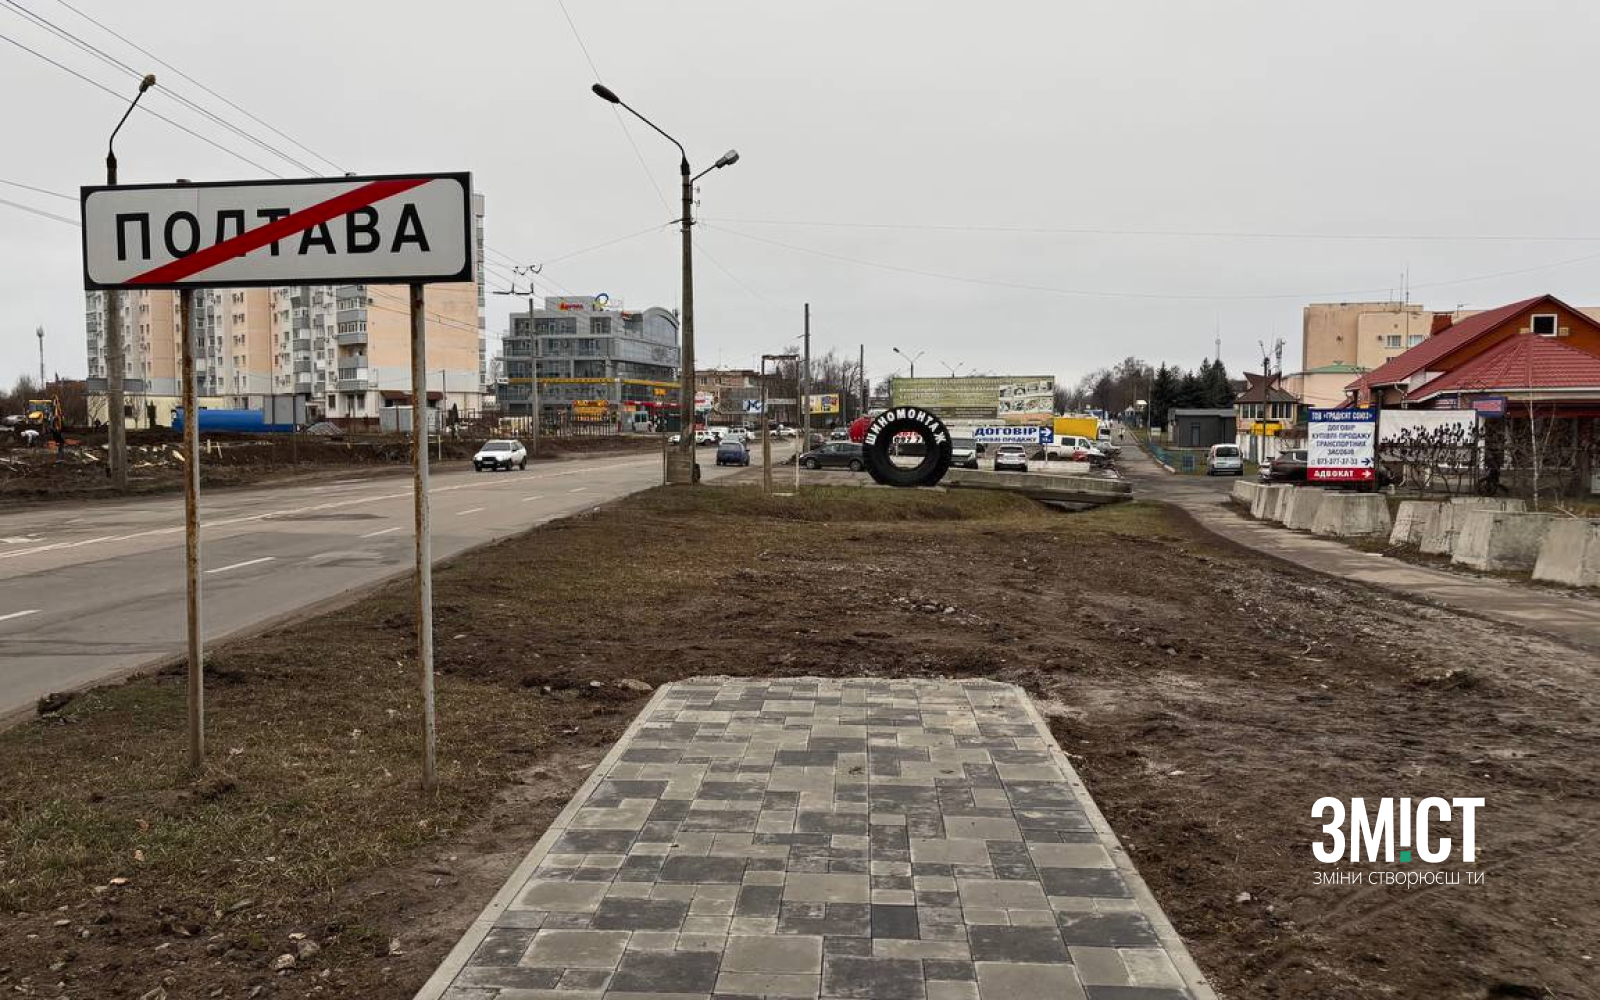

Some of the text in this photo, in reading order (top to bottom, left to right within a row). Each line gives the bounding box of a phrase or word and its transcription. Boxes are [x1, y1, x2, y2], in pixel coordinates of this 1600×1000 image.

[115, 202, 431, 262] ПОЛТАВА
[864, 408, 947, 446] ШИНОМОНТАЖ
[1327, 424, 1356, 432] ДОГОВІР
[974, 427, 1037, 437] ДОГОВІР
[1338, 432, 1372, 440] ПРОДАЖУ
[1316, 440, 1366, 448] ТРАНСПОРТНИХ
[1327, 448, 1355, 456] ЗАСОБІВ
[1313, 470, 1355, 479] АДВОКАТ
